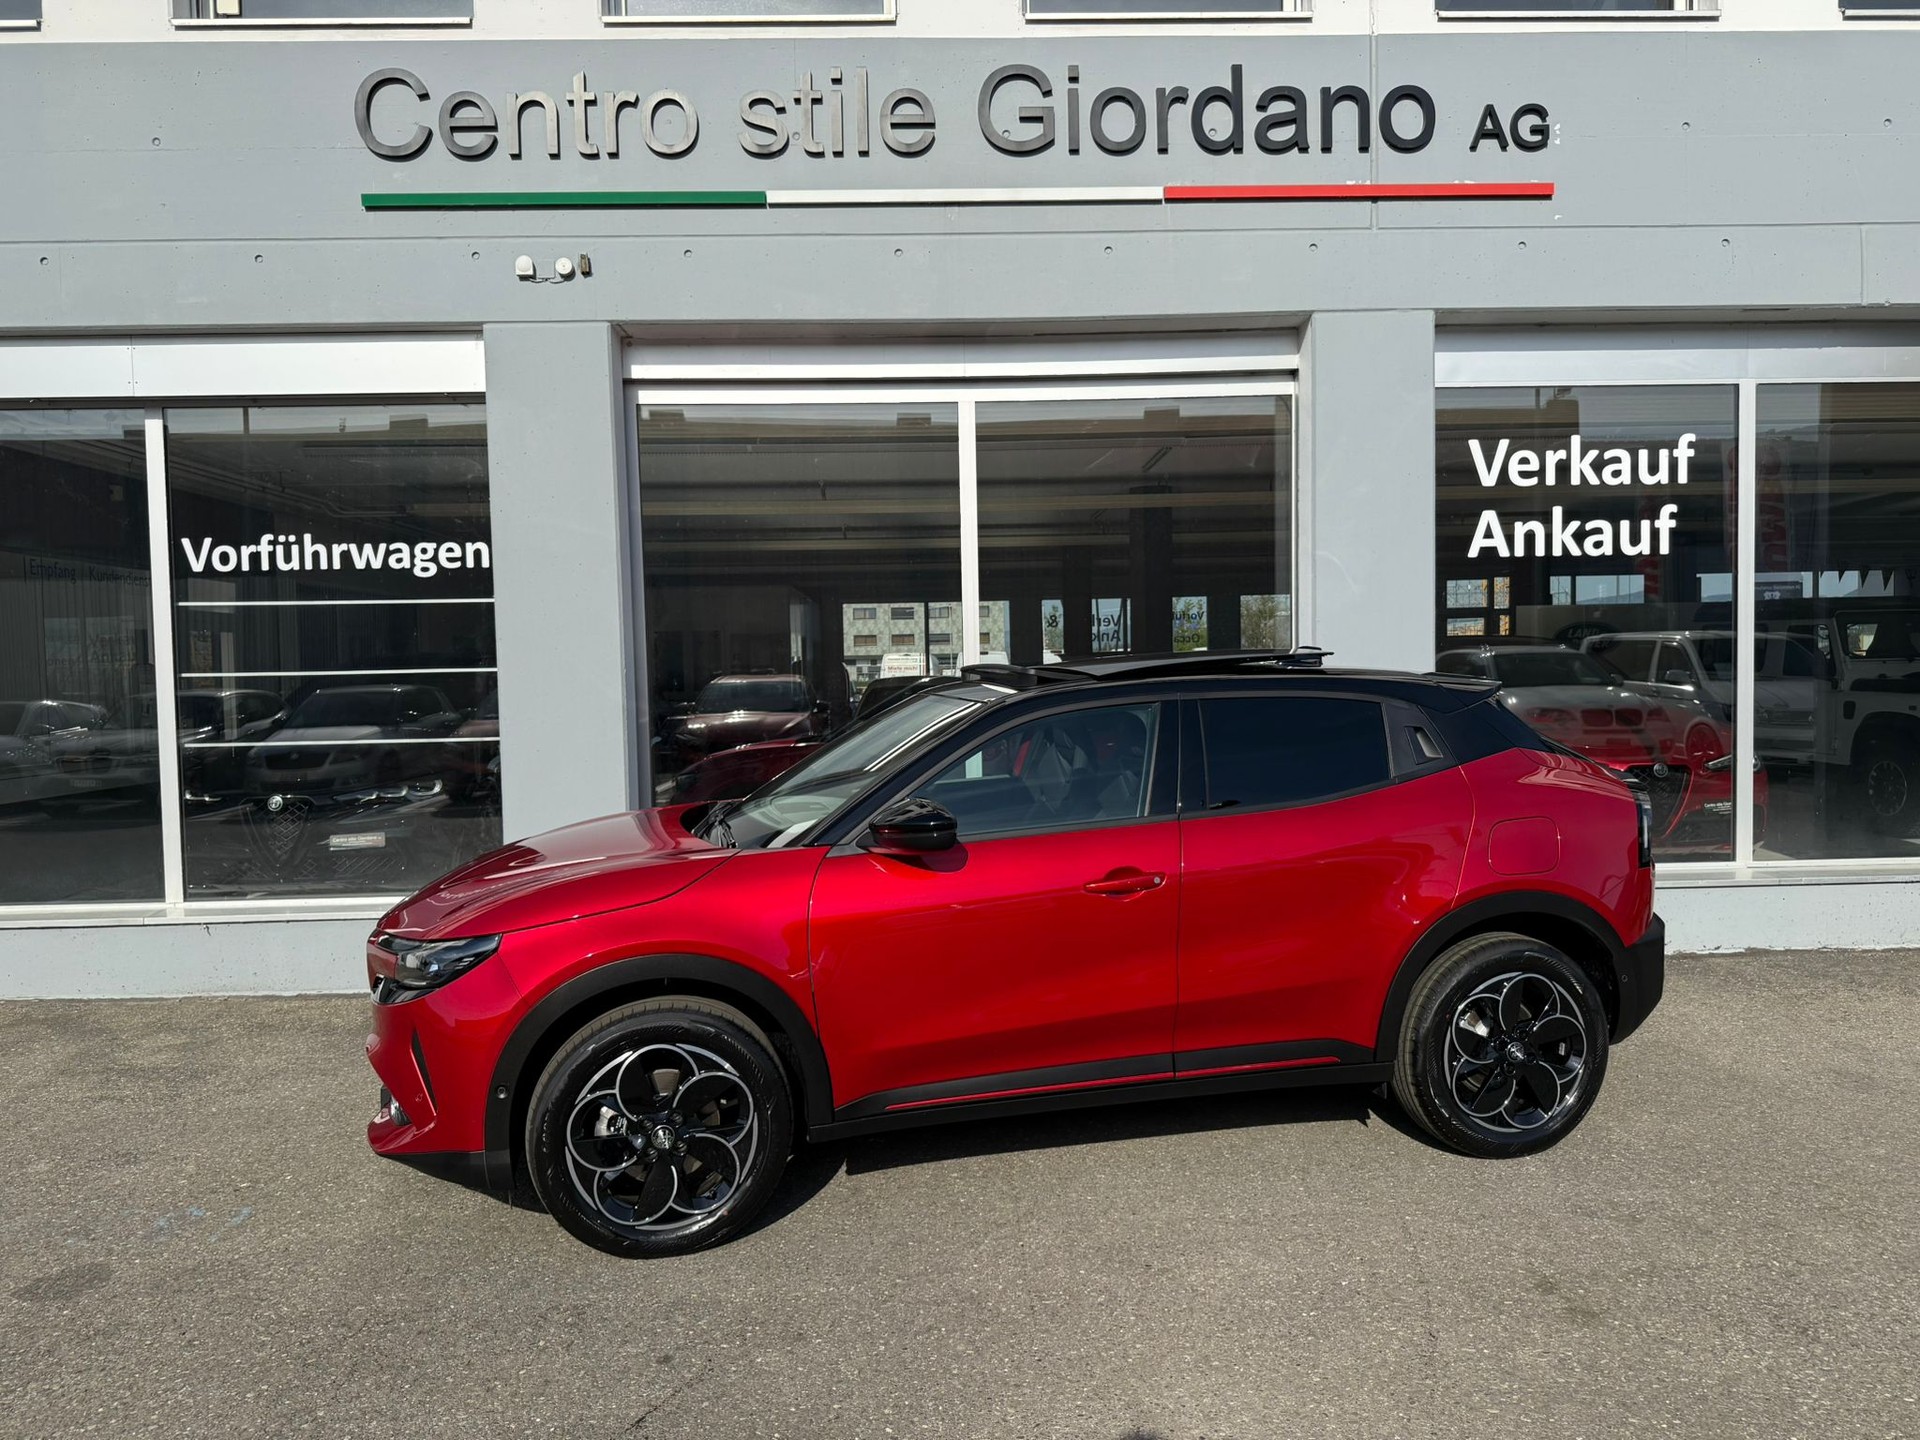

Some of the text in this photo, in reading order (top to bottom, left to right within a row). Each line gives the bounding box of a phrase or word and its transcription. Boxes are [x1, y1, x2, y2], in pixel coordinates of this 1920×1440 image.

[354, 63, 1551, 161] Centro stile Giordano AG
[1467, 433, 1696, 487] Verkauf
[180, 533, 490, 577] Vorführwagen
[1467, 503, 1678, 558] Ankauf
[29, 558, 151, 588] Empfang Kundendiens
